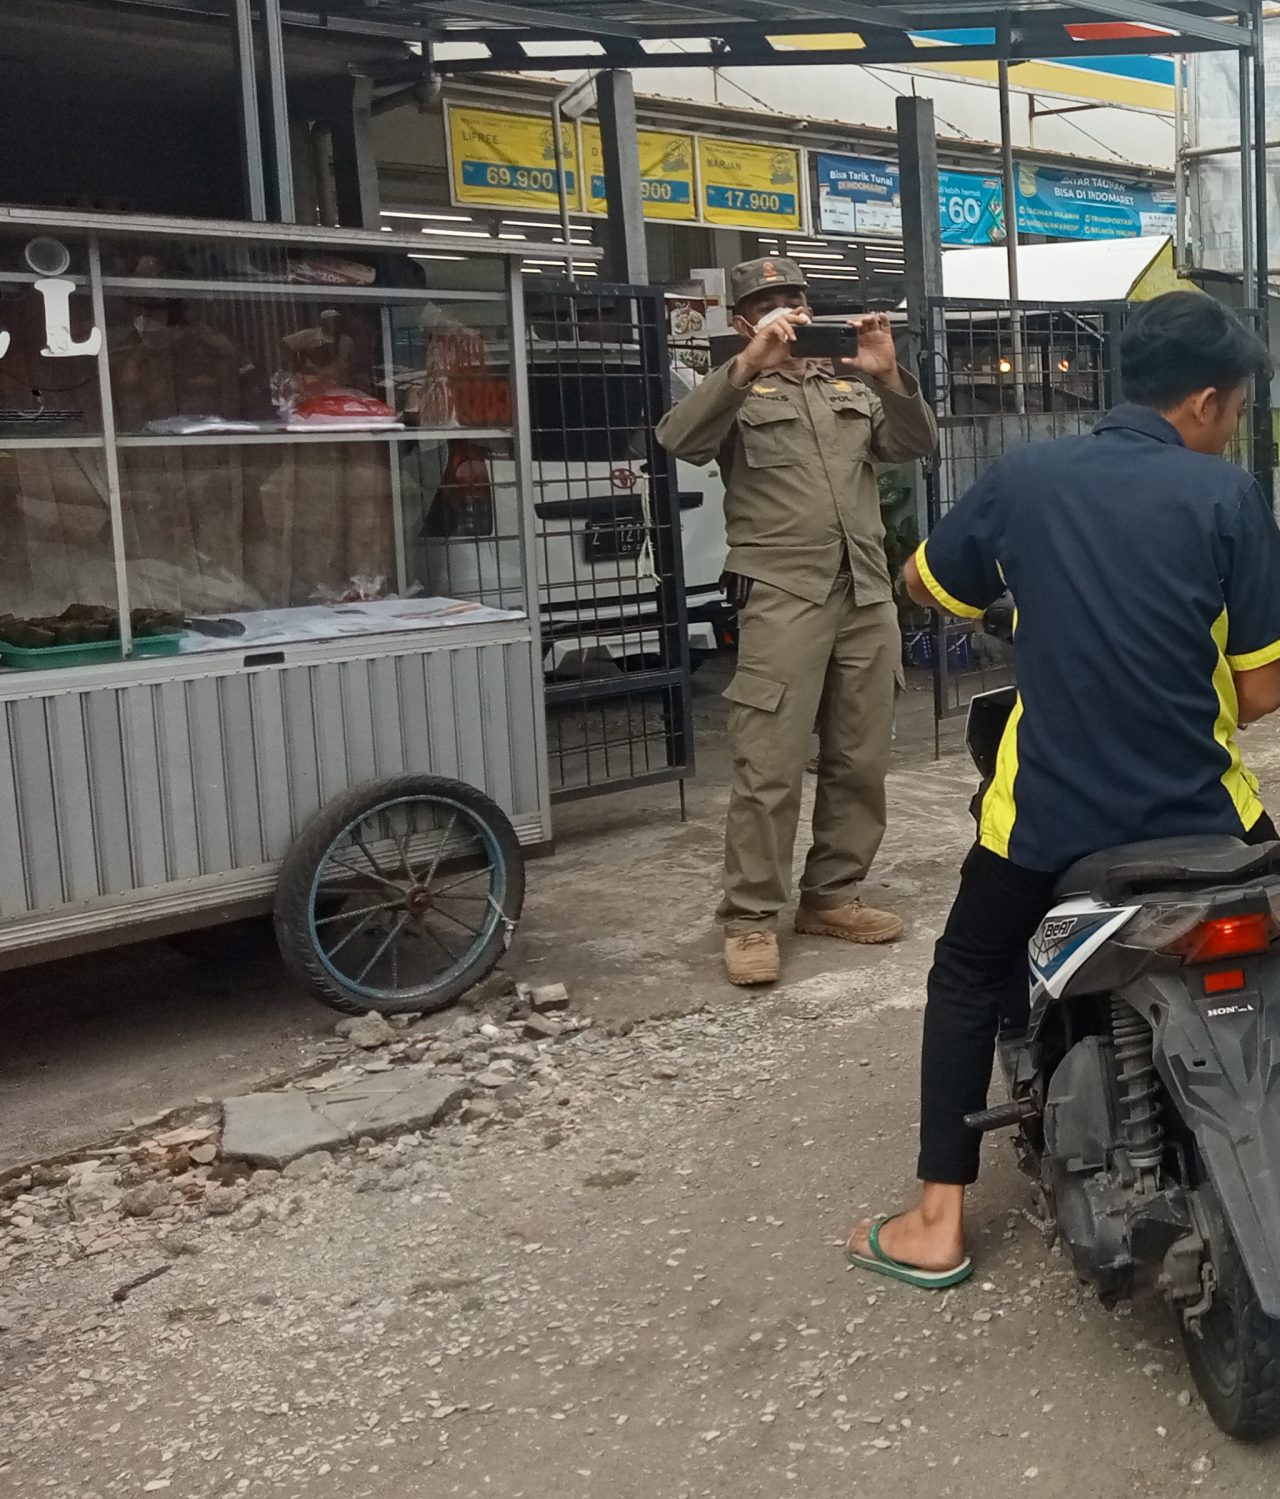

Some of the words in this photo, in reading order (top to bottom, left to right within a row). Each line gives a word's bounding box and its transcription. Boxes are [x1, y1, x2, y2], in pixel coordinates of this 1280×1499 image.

[462, 131, 500, 145] LIFREE
[487, 166, 553, 190] 69.900
[829, 170, 847, 179] Bisa
[848, 171, 869, 181] Tarik
[870, 173, 893, 186] Tunai
[724, 190, 780, 211] 17.900
[1054, 187, 1075, 198] BISA
[1076, 189, 1087, 199] DI
[1087, 191, 1134, 206] INDOMARET
[949, 196, 980, 225] 60
[1044, 918, 1078, 940] BeAT
[1207, 1004, 1254, 1017] HON
